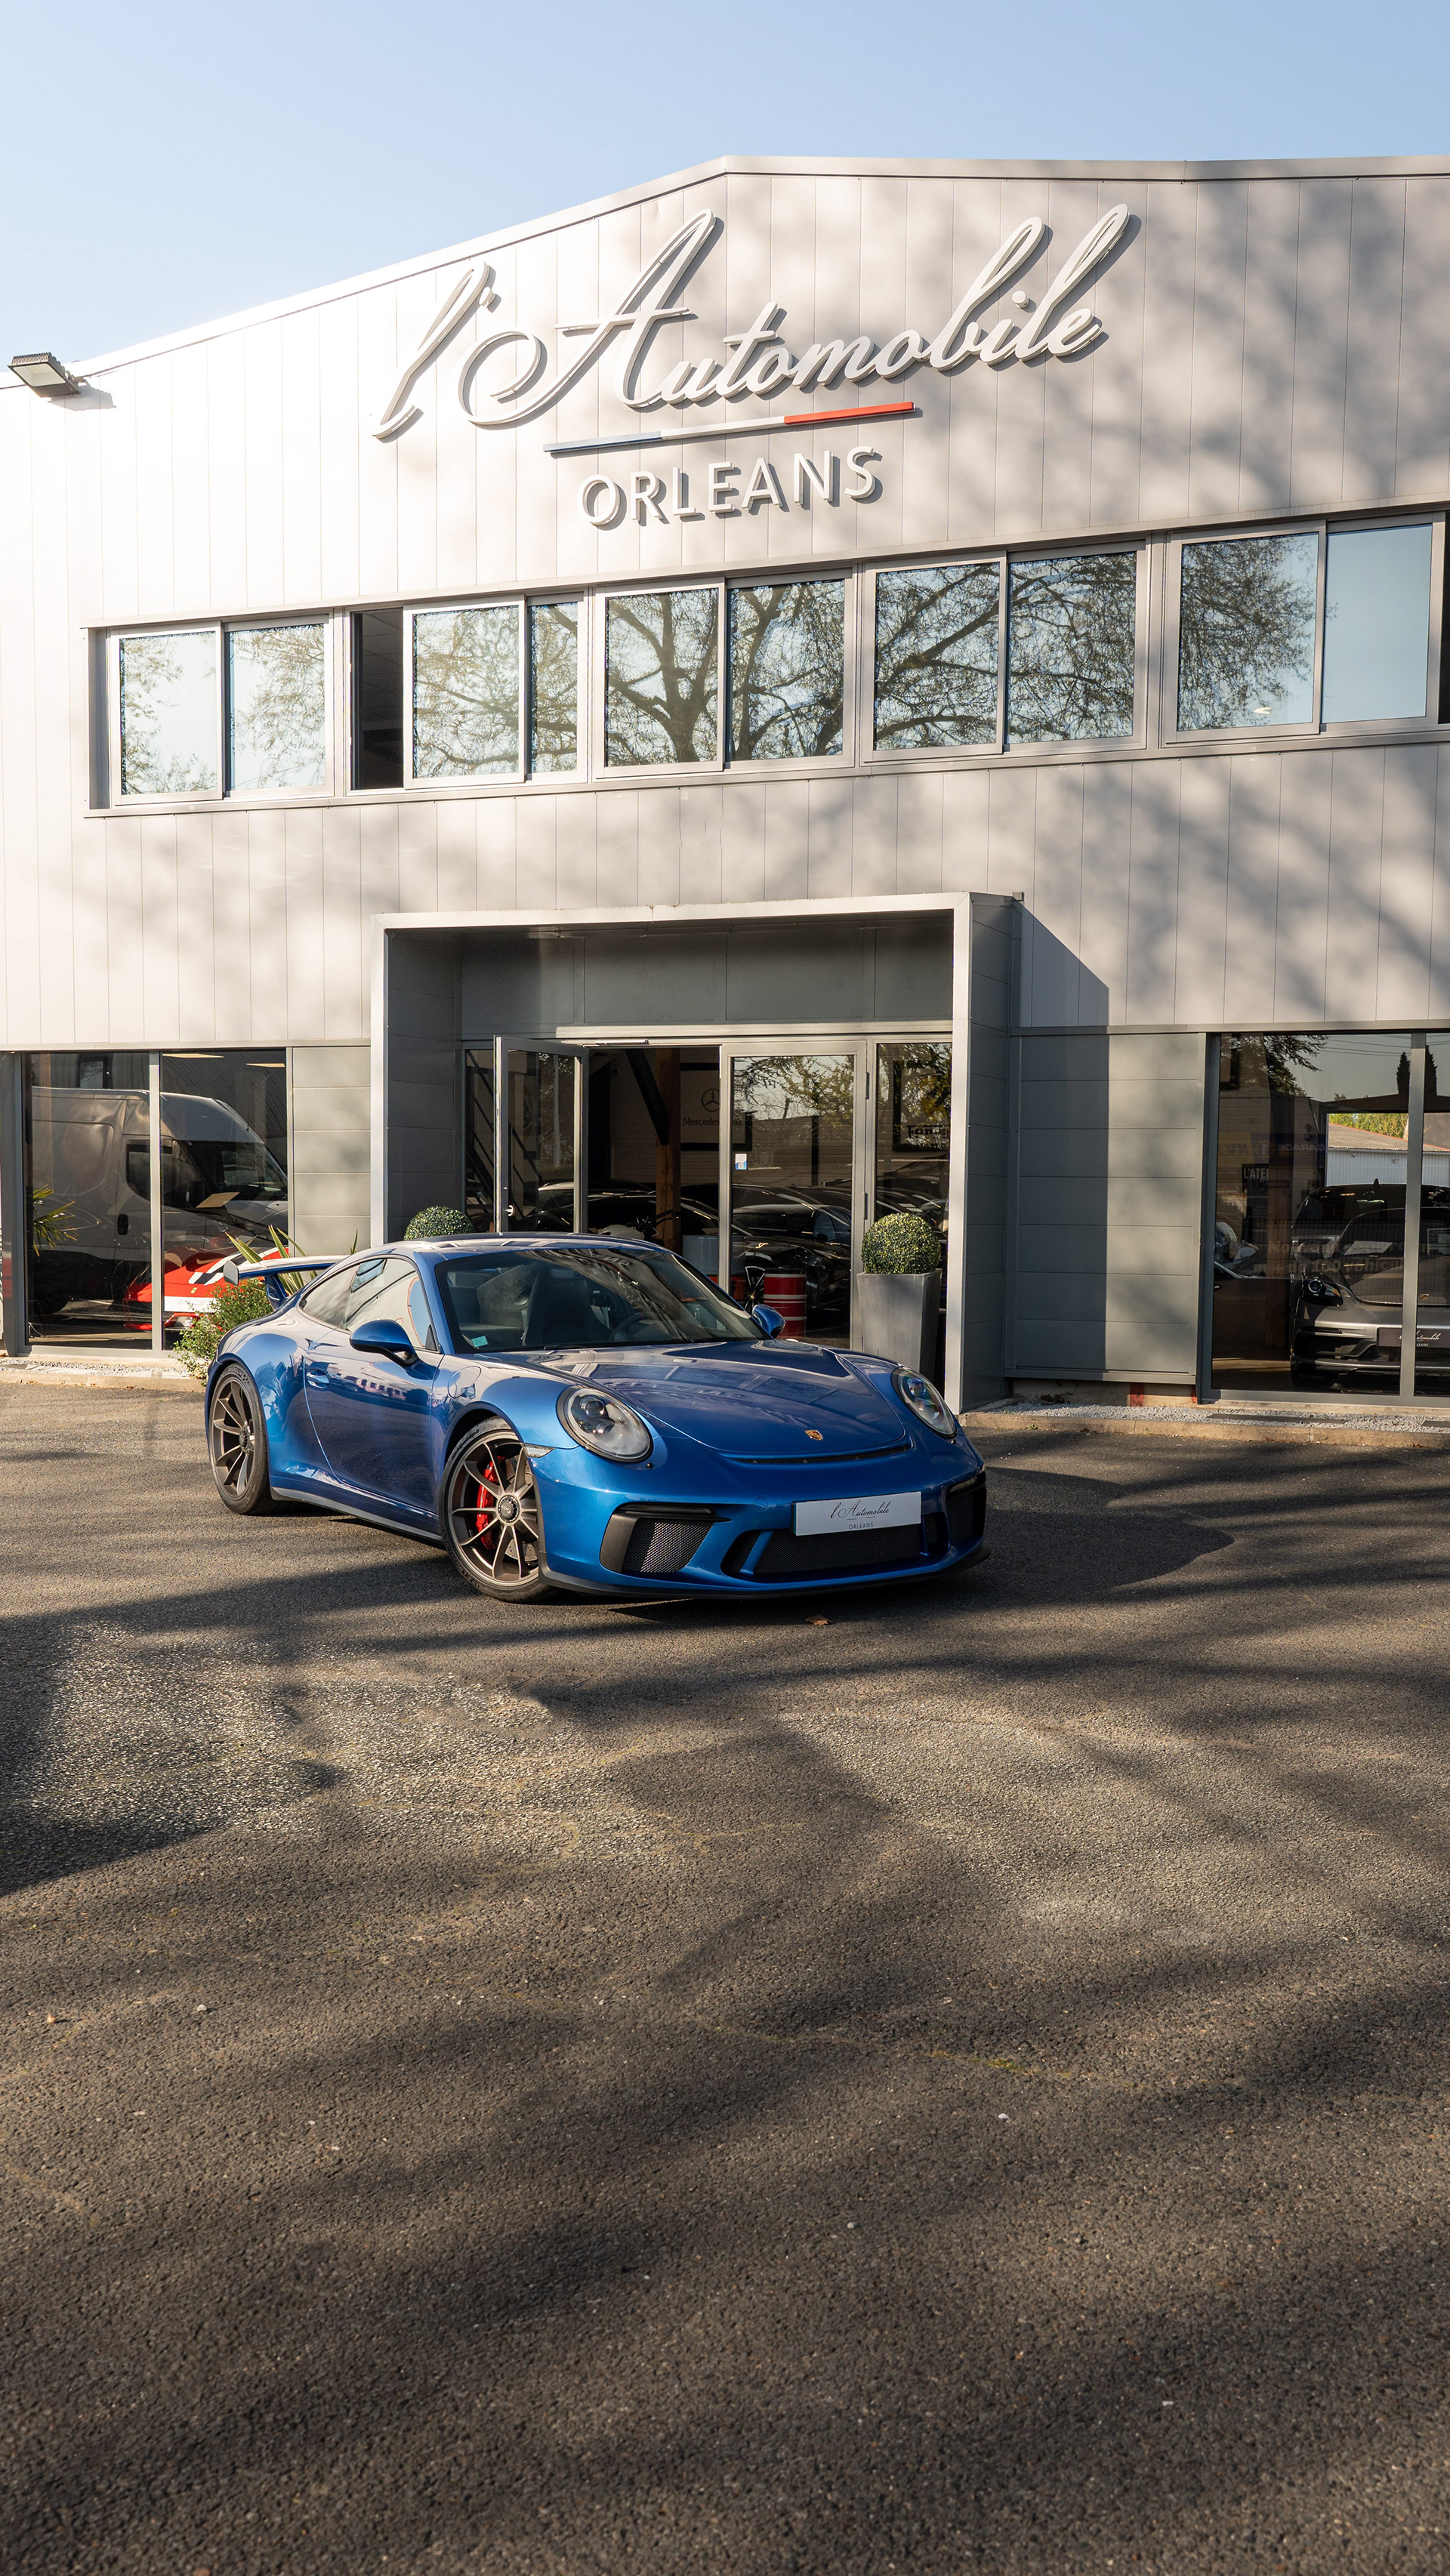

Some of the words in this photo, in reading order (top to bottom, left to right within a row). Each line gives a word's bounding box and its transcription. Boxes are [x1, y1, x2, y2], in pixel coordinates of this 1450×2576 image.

[372, 204, 1131, 439] l'Automobile
[578, 445, 881, 526] ORLEANS
[831, 1499, 891, 1518] l'Automobile
